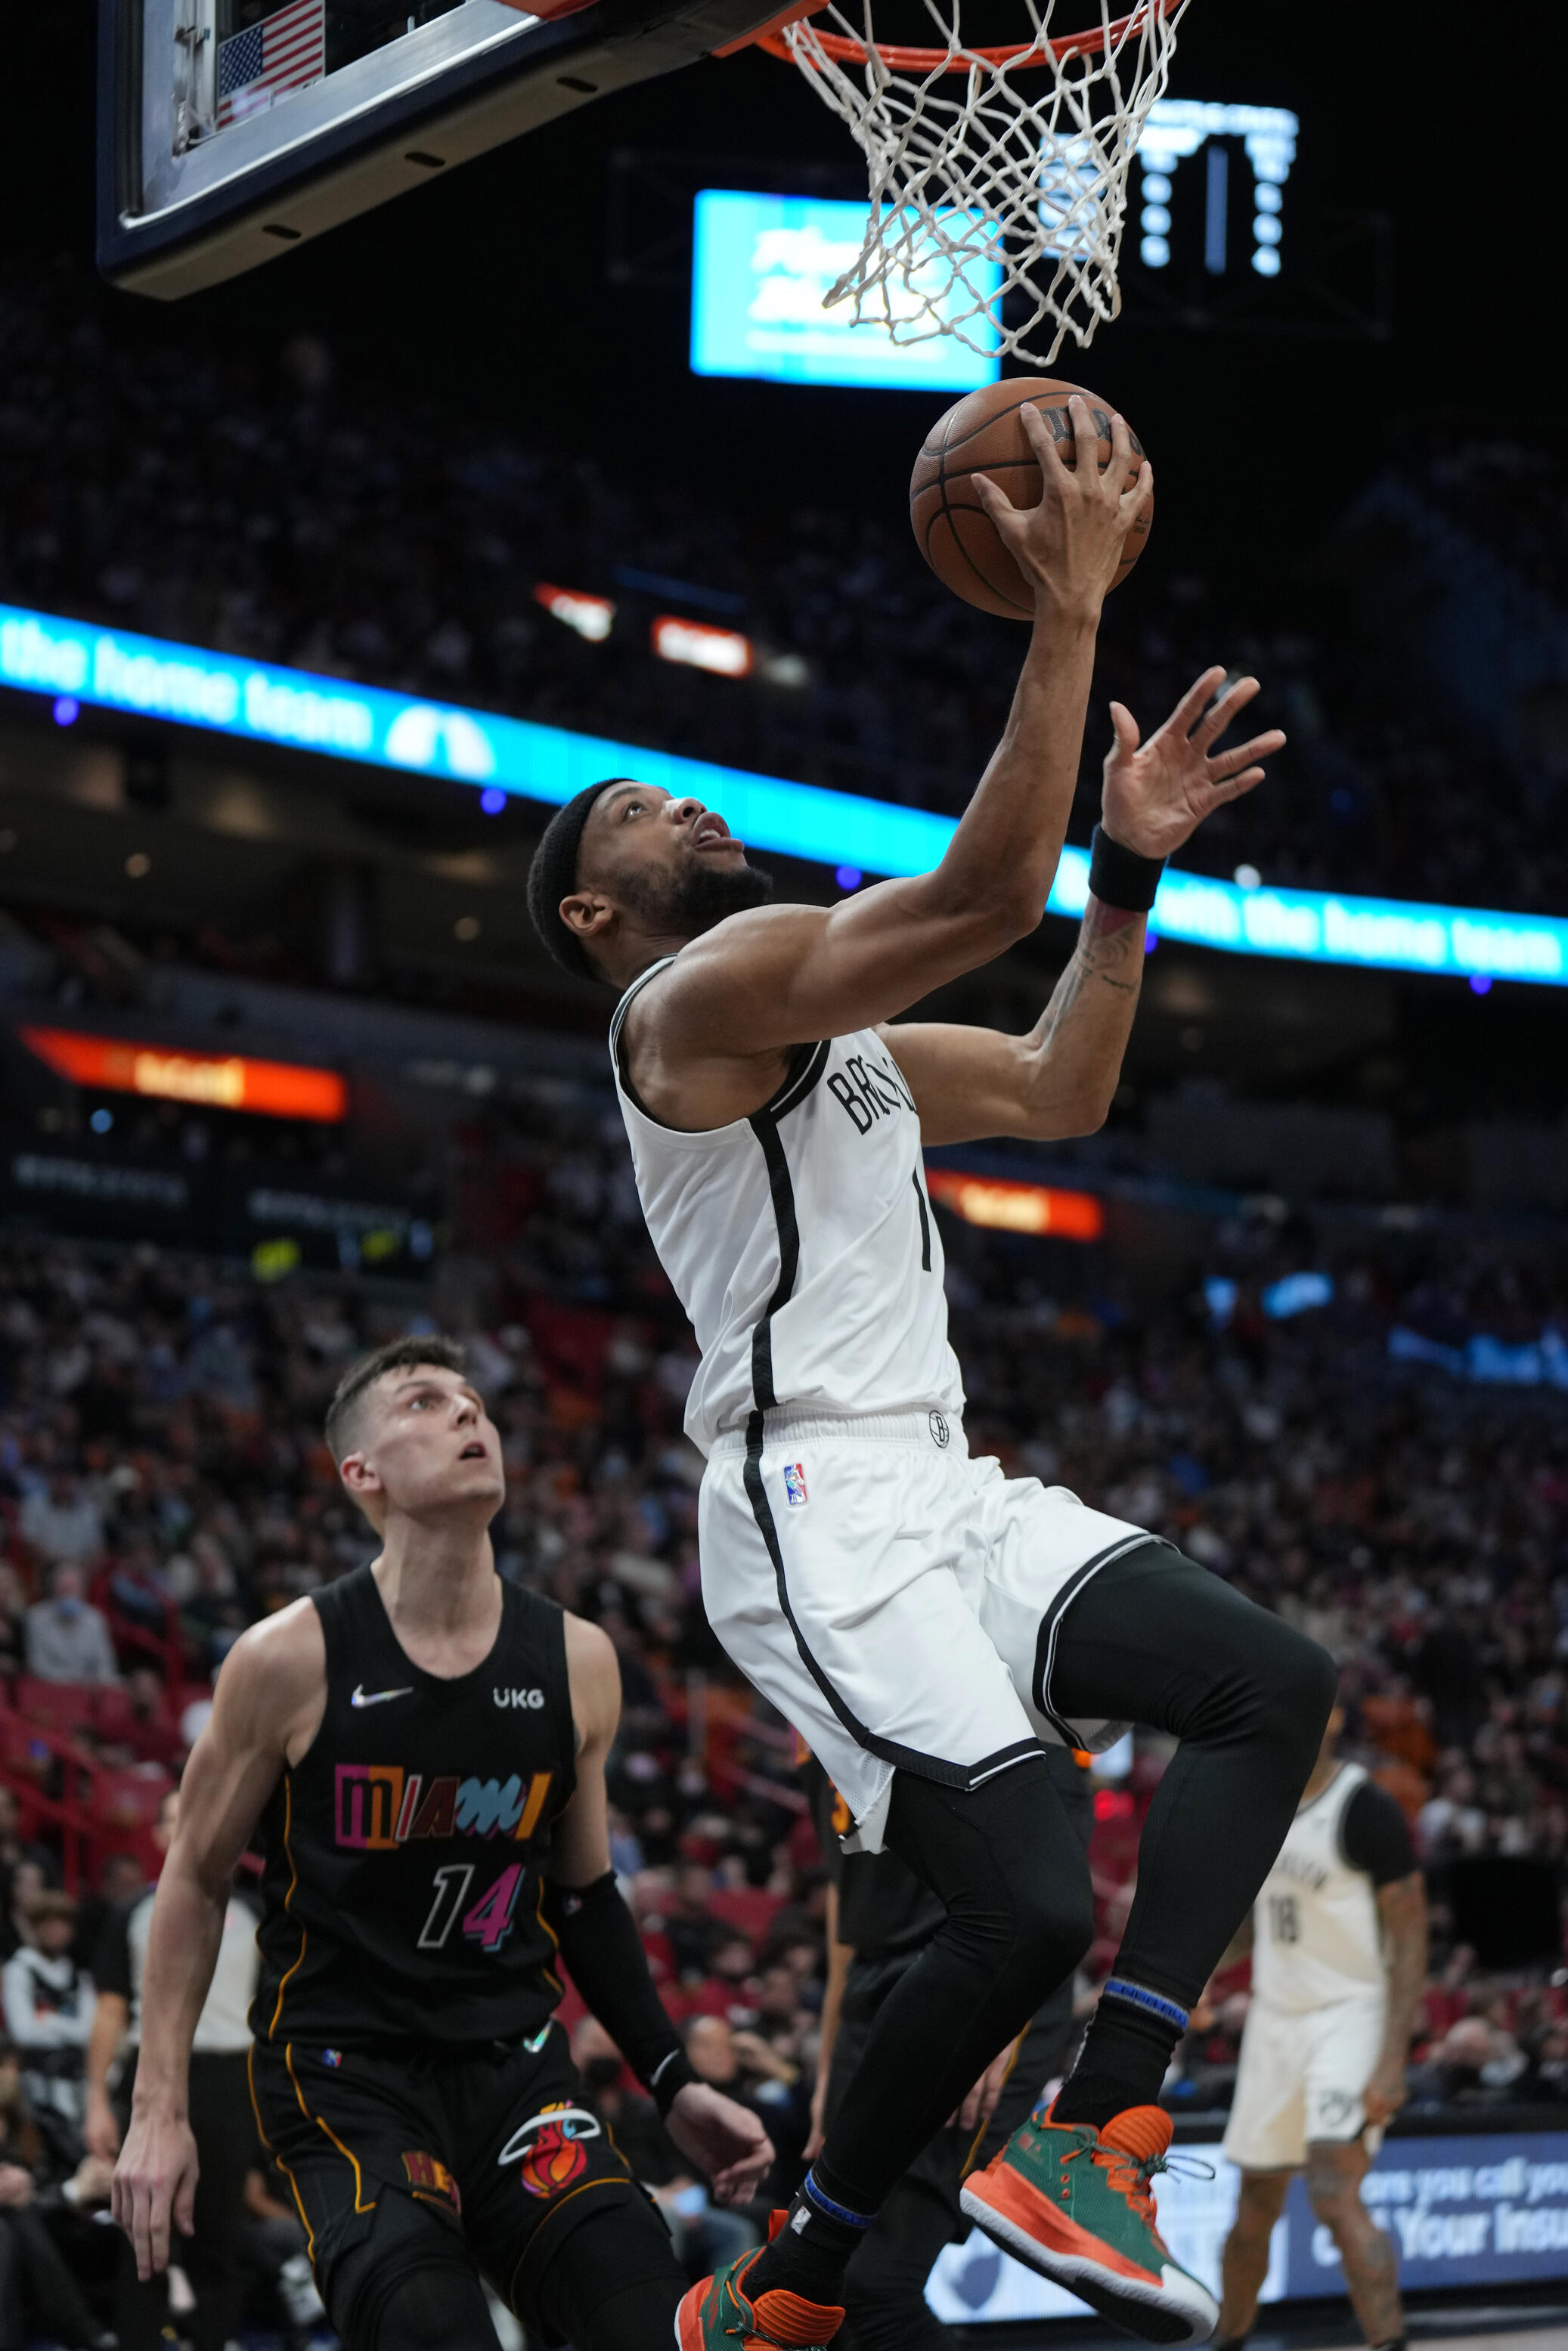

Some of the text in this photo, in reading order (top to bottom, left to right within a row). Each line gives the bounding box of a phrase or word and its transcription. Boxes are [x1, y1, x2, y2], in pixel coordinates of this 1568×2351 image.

[493, 1687, 545, 1708] UKG
[417, 1863, 526, 1952] 14
[1393, 2205, 1490, 2261] Your
